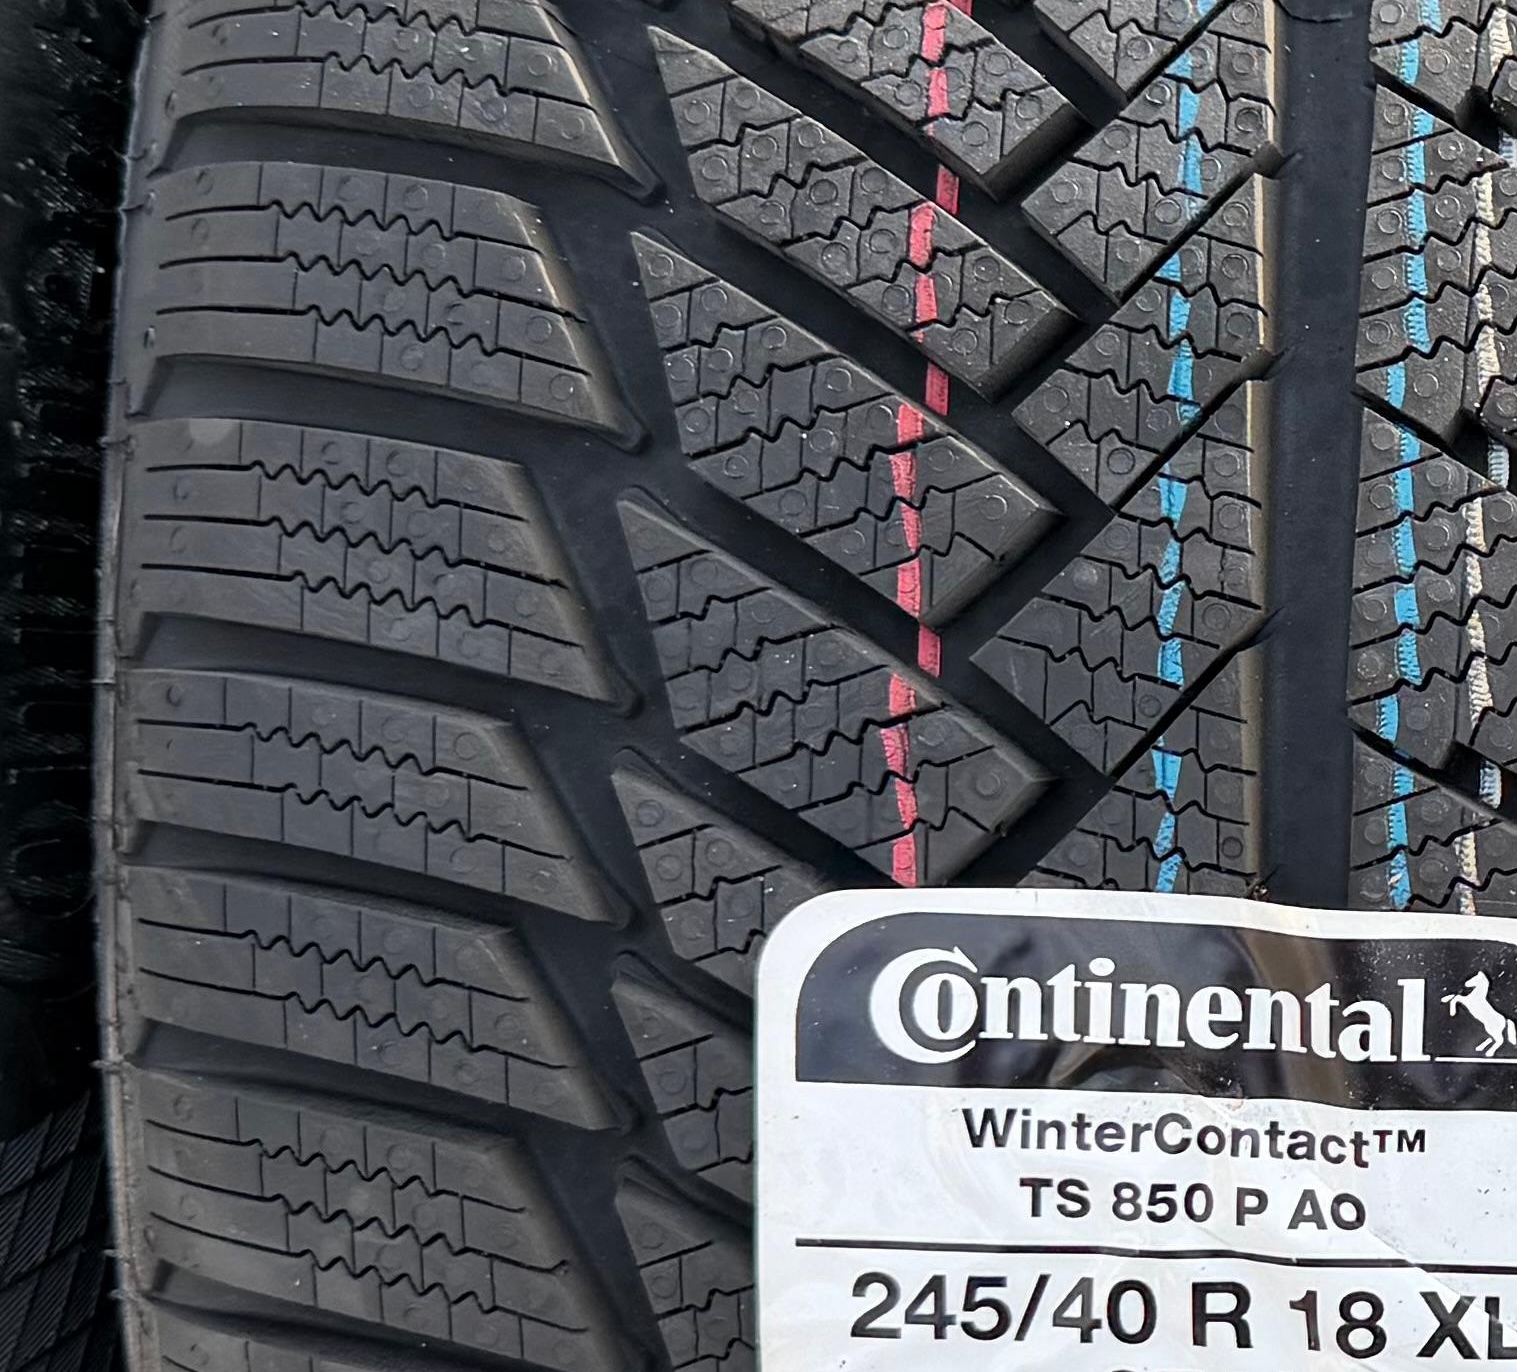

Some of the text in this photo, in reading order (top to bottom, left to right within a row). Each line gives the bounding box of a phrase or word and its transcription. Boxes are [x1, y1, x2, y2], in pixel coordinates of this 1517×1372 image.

[869, 945, 1433, 1064] Continental
[1018, 1176, 1367, 1231] TS 850 P AO
[849, 1270, 1157, 1345] 245/40
[1191, 1281, 1253, 1350] R
[1289, 1288, 1388, 1361] 18
